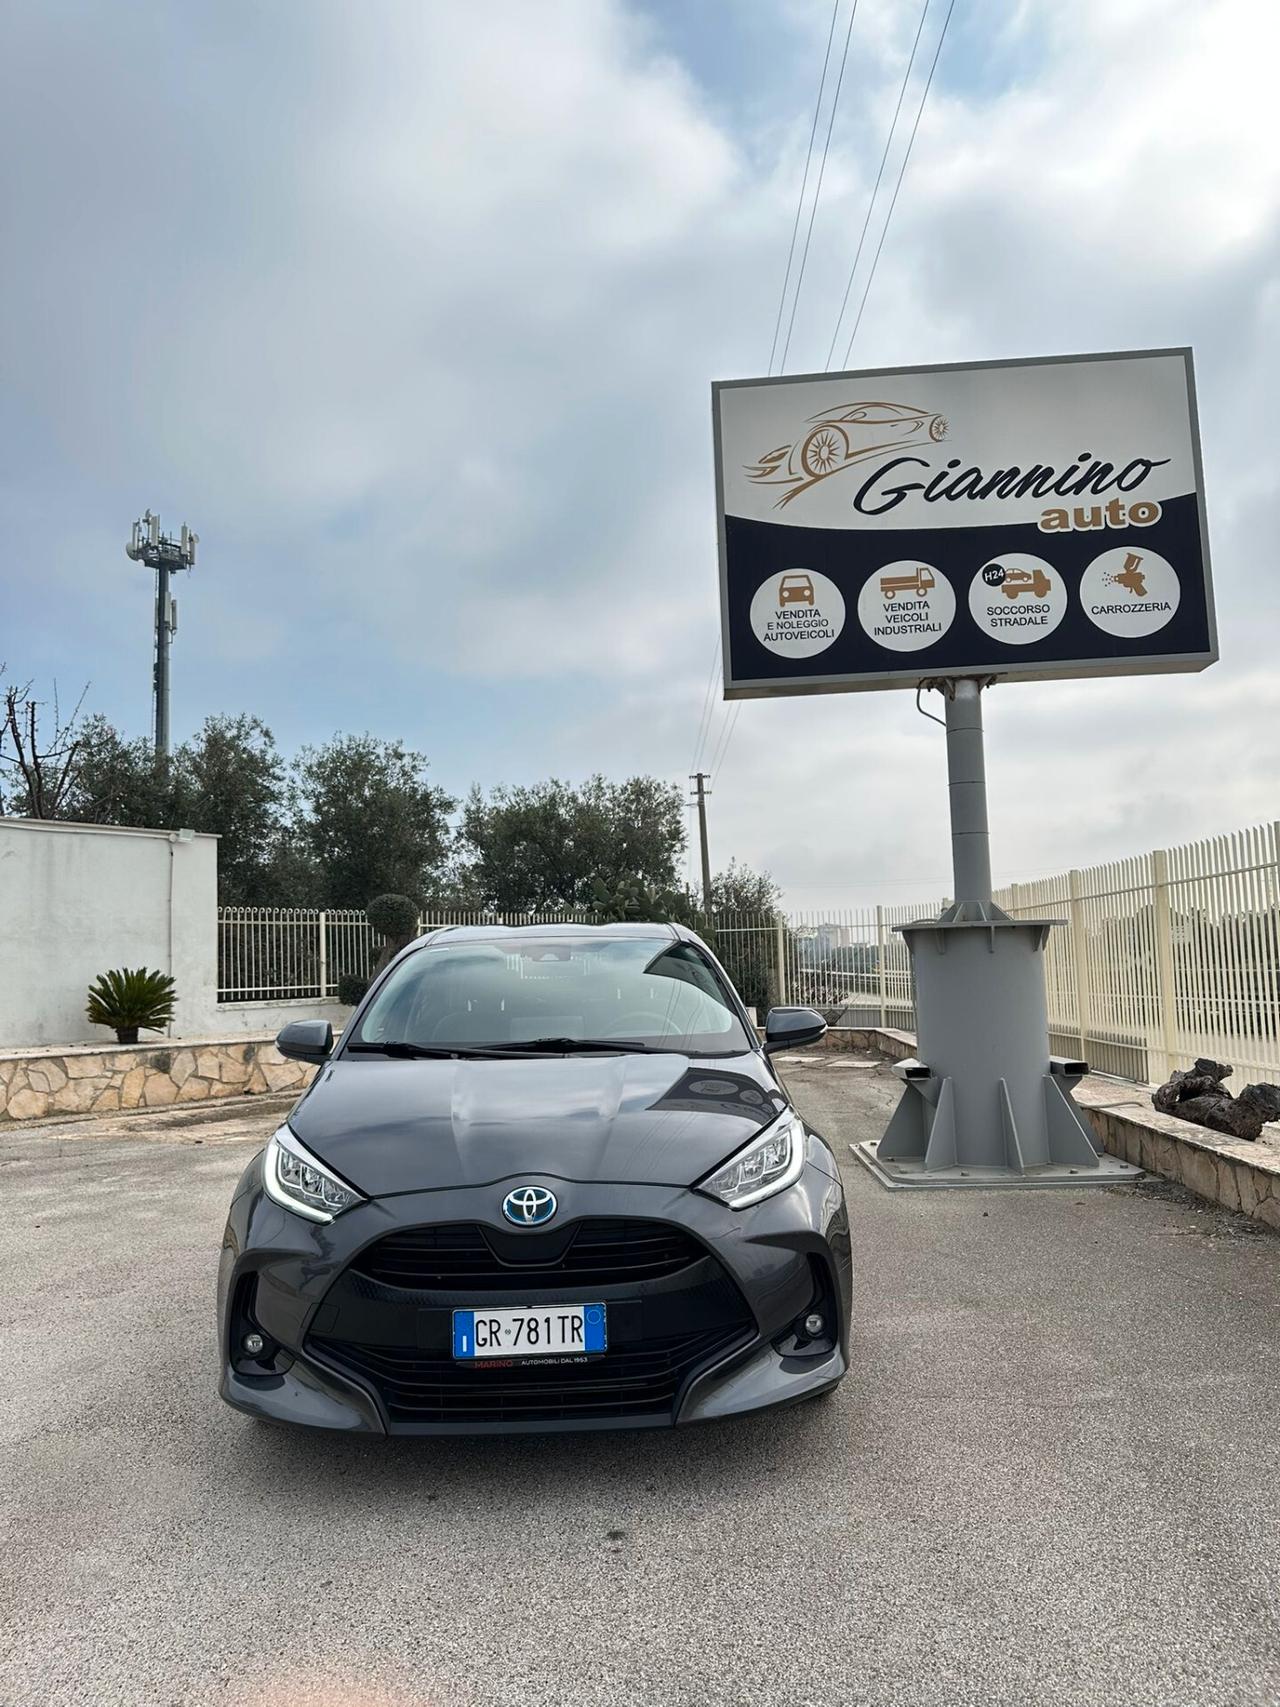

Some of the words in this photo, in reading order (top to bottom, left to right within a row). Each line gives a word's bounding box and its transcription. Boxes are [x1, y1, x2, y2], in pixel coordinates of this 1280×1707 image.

[853, 451, 1171, 515] Giannino
[1039, 497, 1160, 532] auto
[984, 568, 1005, 582] H24
[883, 601, 930, 612] VENDITA
[986, 604, 1051, 616] SOCCORSO
[1091, 602, 1172, 615] CARROZZERIA
[775, 609, 821, 620] VENDITA
[885, 612, 929, 623] VEICOLI
[767, 622, 774, 631] E
[776, 619, 829, 630] NOLEGGIO
[990, 616, 1049, 627] STRADALE
[874, 622, 942, 636] INDUSTRIALI
[763, 629, 835, 642] AUTOVEICOLI
[474, 1360, 513, 1369] MARINO
